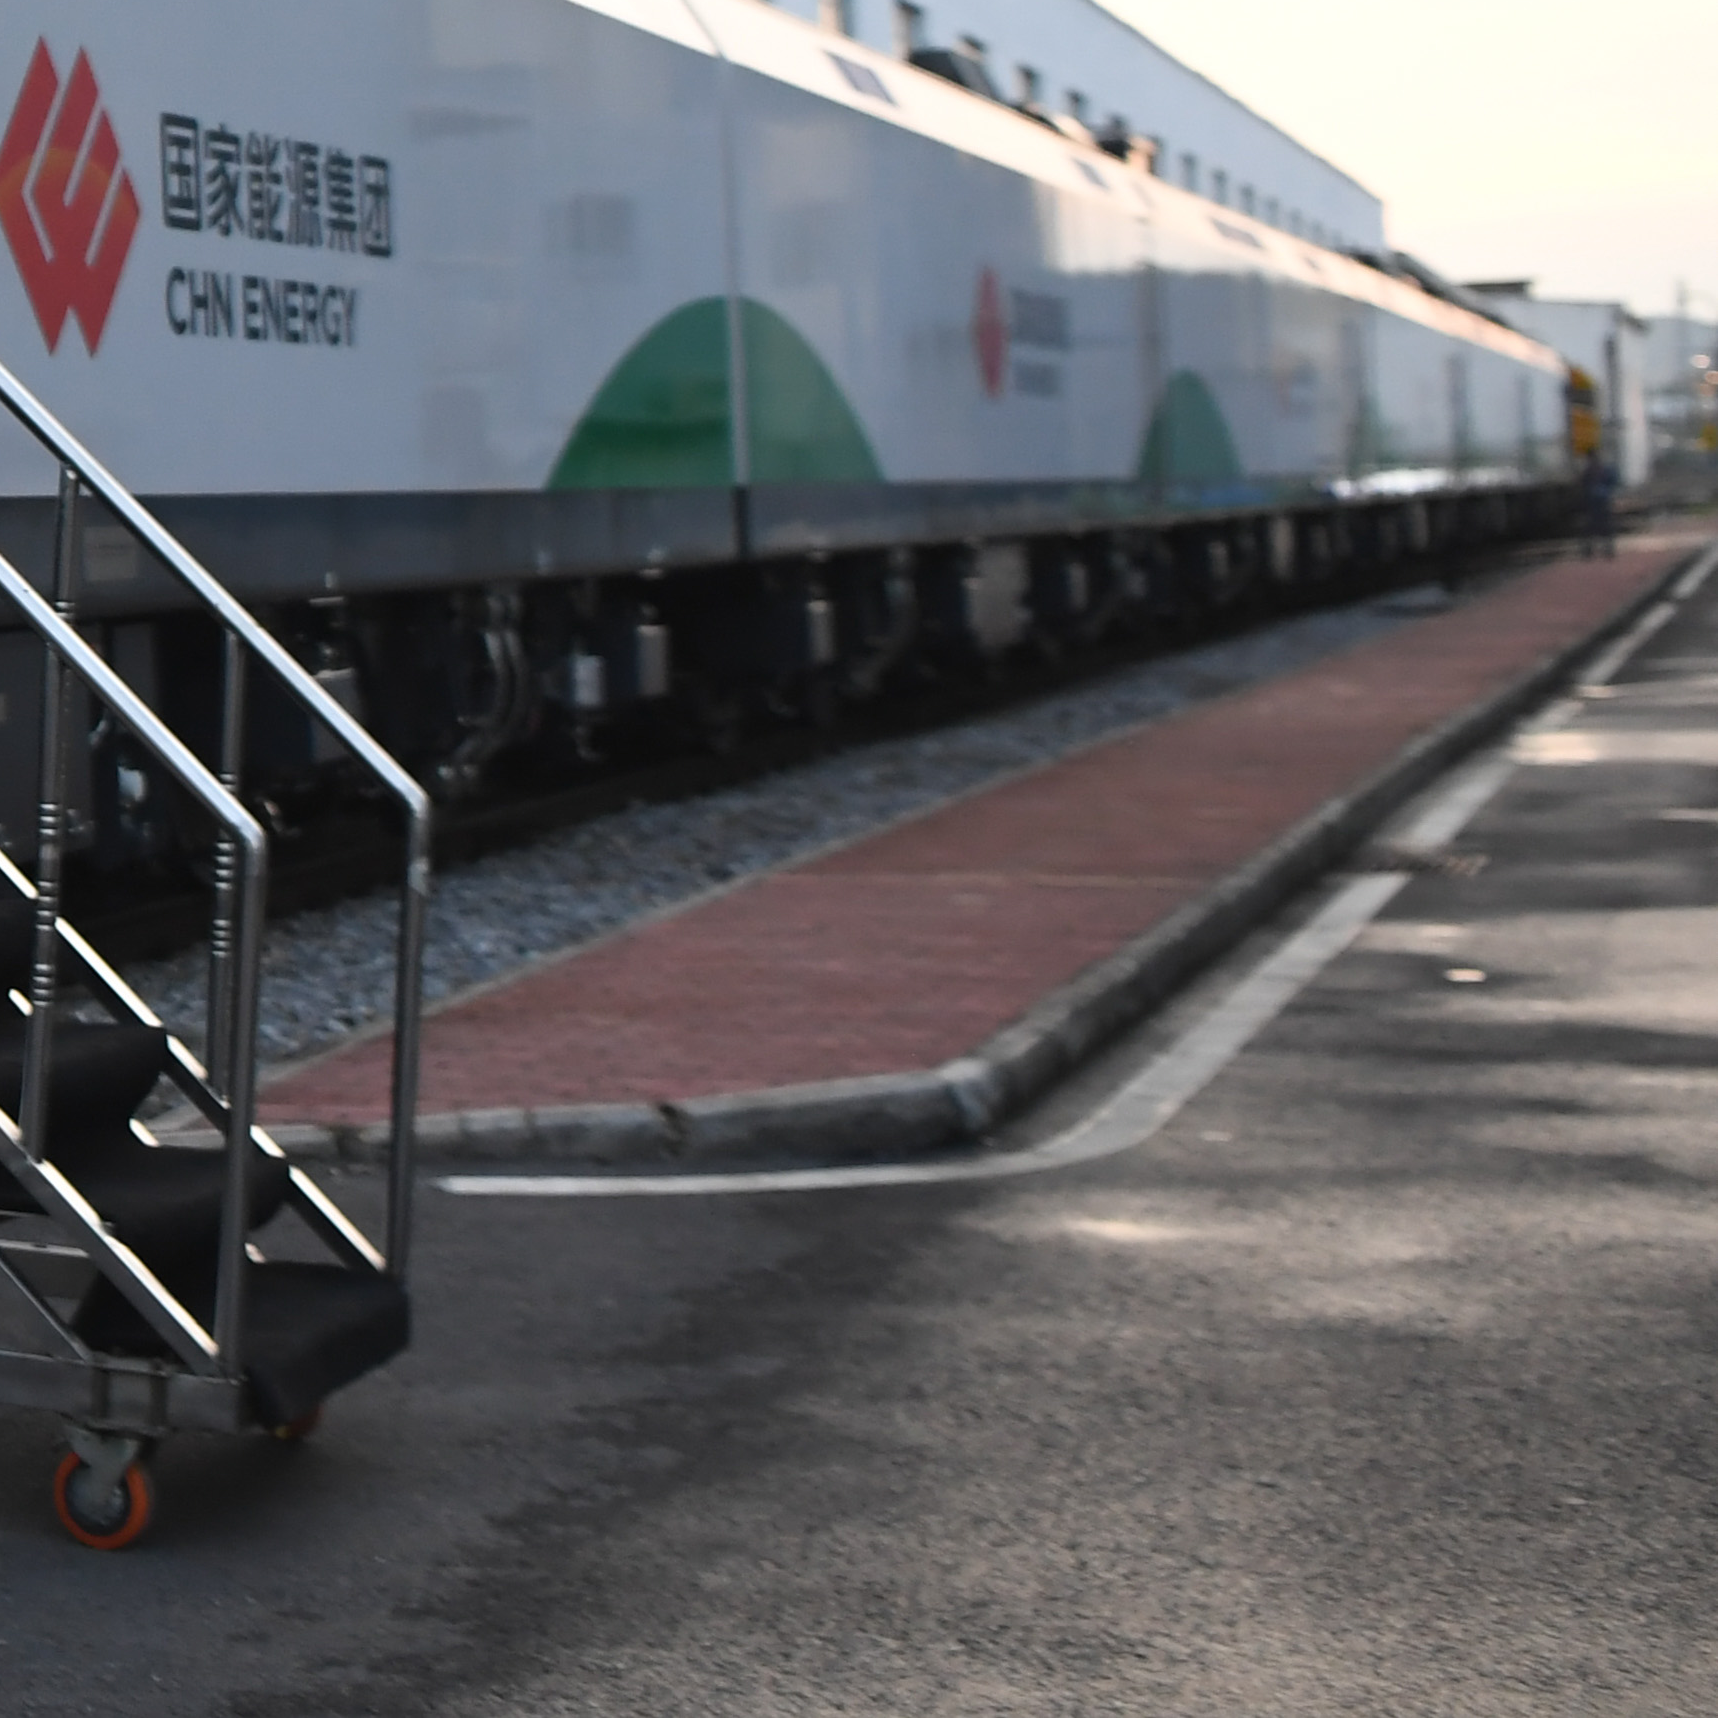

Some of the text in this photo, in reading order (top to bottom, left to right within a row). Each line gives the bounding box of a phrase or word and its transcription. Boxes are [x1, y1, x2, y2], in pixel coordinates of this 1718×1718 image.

[160, 112, 392, 258] 国家能源集团
[166, 267, 359, 347] CHN ENERGY
